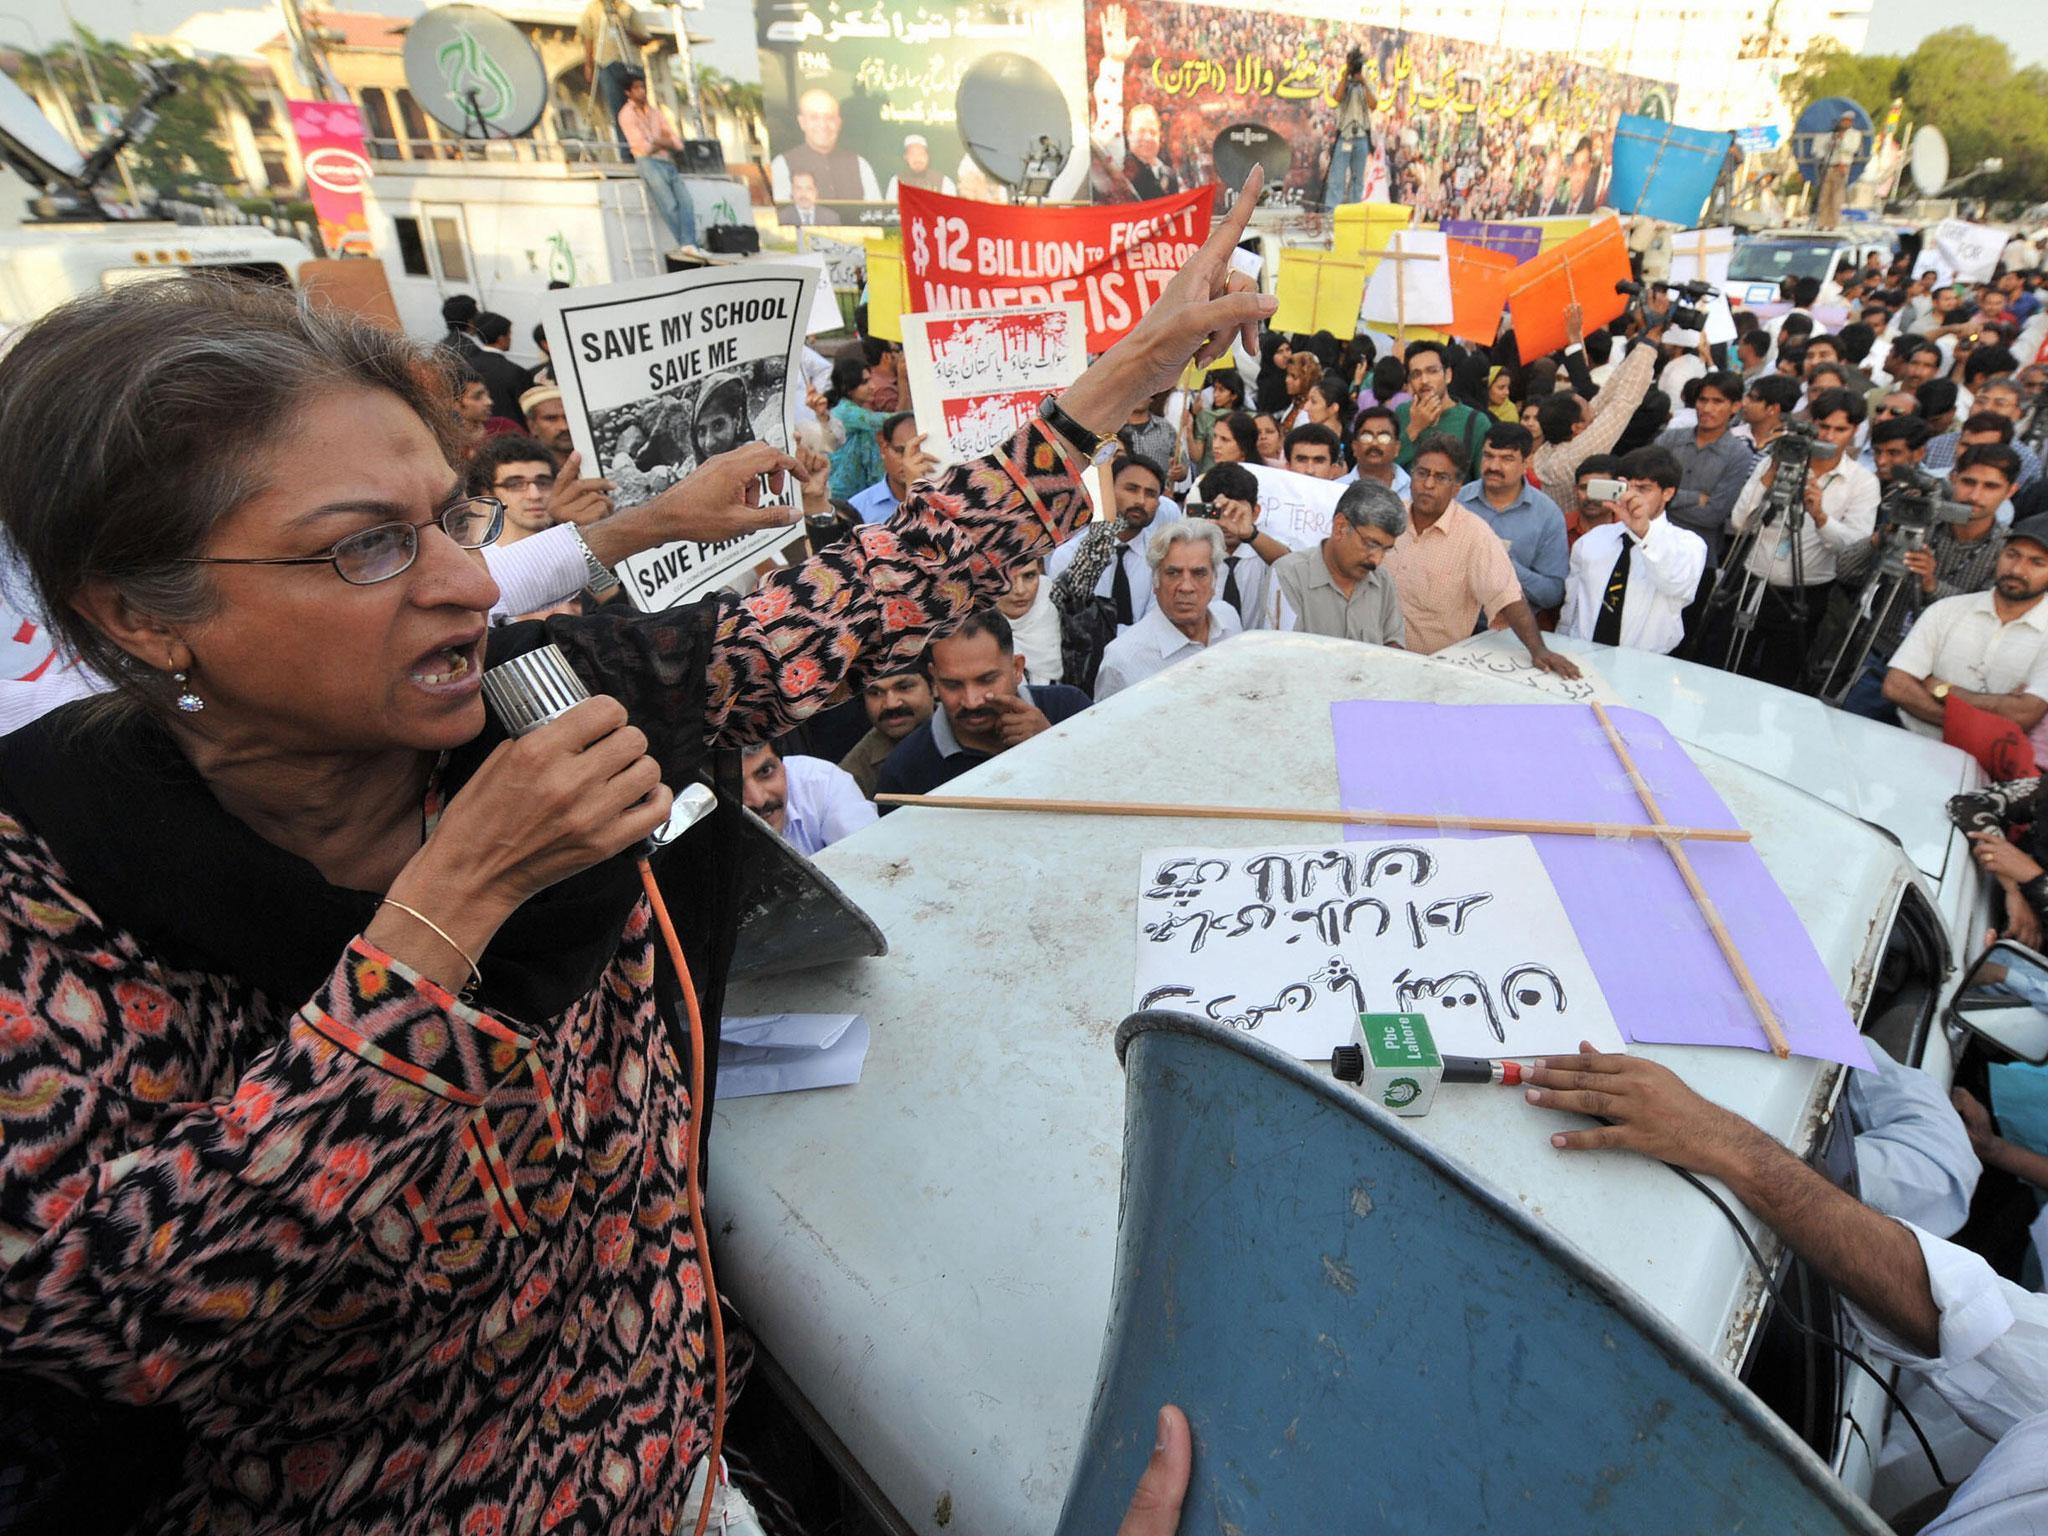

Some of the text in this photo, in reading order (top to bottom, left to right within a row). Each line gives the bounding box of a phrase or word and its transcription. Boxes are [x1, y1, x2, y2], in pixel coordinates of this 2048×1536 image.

[1234, 54, 1273, 96] والا
[977, 238, 1084, 279] BILLION
[1085, 246, 1104, 262] TO
[1085, 272, 1132, 333] IS
[581, 297, 788, 362] SAVE MY SCHOOL
[649, 337, 738, 390] SAVE ME
[961, 349, 1003, 381] پاکستان
[638, 544, 693, 597] SAVE
[1243, 844, 1438, 904] طالبان
[1406, 892, 1494, 949] اور
[1399, 1017, 1422, 1060] Lahore
